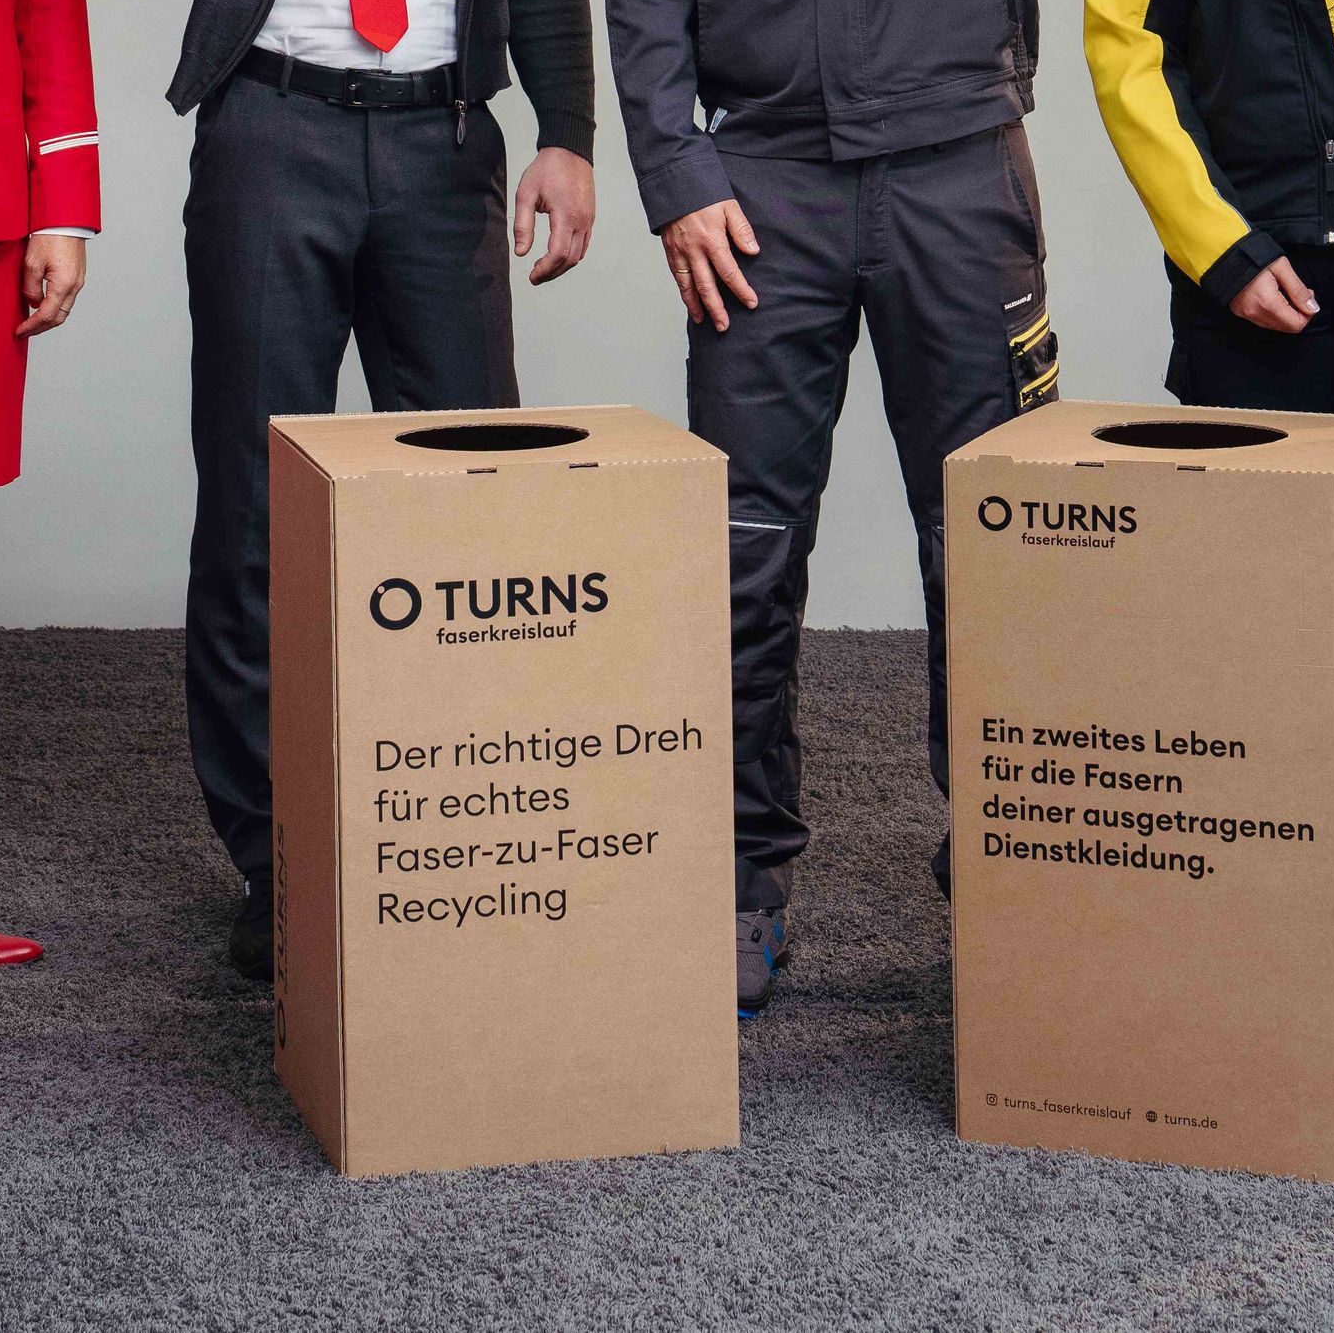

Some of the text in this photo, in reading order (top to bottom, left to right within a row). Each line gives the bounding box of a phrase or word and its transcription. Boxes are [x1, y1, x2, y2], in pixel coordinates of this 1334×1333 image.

[1020, 502, 1138, 534] TURNS
[1020, 531, 1116, 549] faserkreislauf
[436, 572, 609, 622] TURNS
[436, 620, 577, 645] faserkreislauf
[375, 718, 703, 772] Der richtige Dreh
[982, 717, 1246, 759] Ein zweites Leben
[981, 754, 1183, 794] für die Fasern
[373, 782, 570, 823] für echtes
[982, 794, 1315, 844] deiner ausgetragenen
[377, 828, 659, 874] Faser-zu-Faser
[984, 831, 1215, 880] Dienstkleidung.
[378, 882, 567, 928] Recycling
[1004, 1096, 1218, 1130] turns_faserkreislauf turns.de
